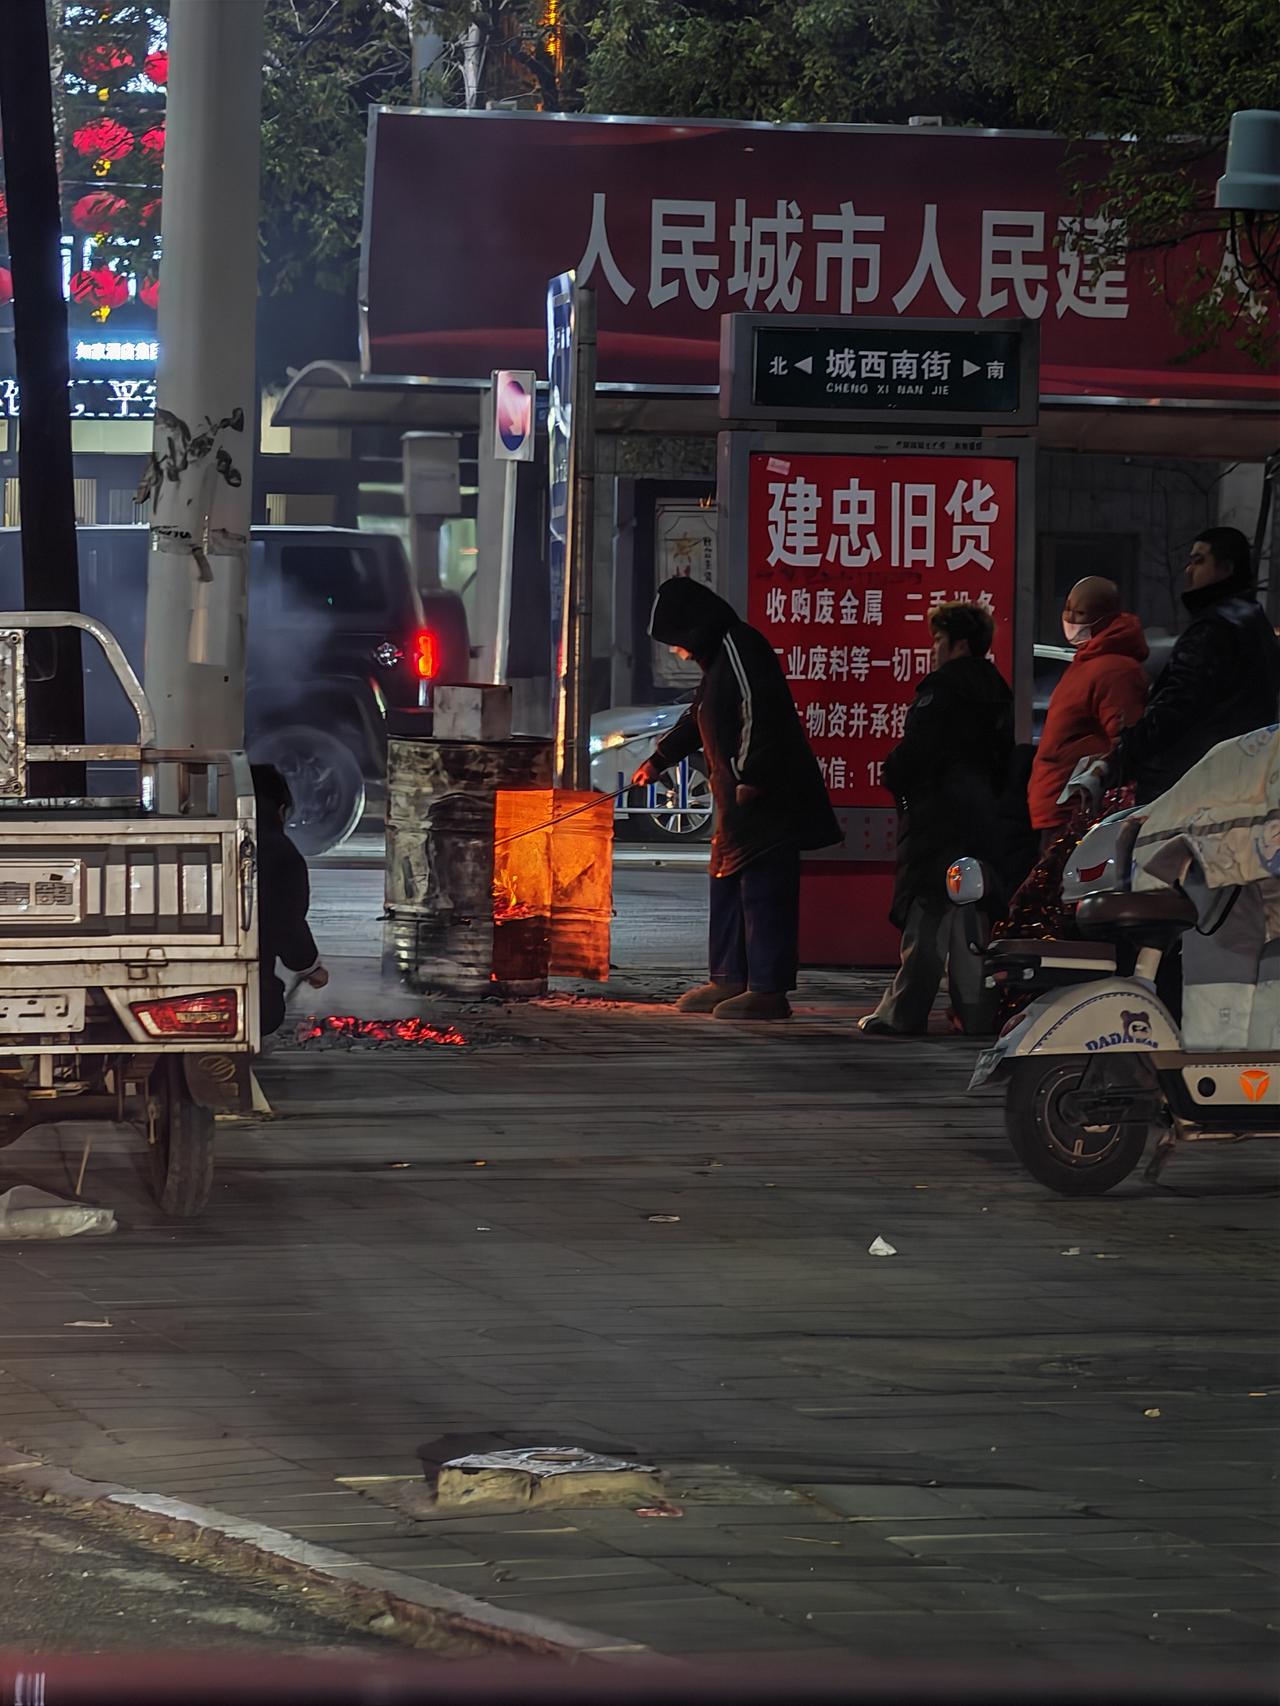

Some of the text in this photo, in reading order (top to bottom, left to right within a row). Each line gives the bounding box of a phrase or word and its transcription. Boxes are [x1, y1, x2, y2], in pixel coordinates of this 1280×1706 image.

[577, 192, 1129, 320] 人民城市人民建
[769, 348, 1005, 380] 北 城西南街 南
[877, 384, 889, 394] XI
[897, 384, 924, 395] NAN
[932, 384, 949, 396] JIE
[766, 476, 999, 572] 建忠旧货
[766, 587, 883, 626] 收购废金属
[773, 646, 931, 681] 业废料等一切可
[796, 702, 906, 738] 物资并承接
